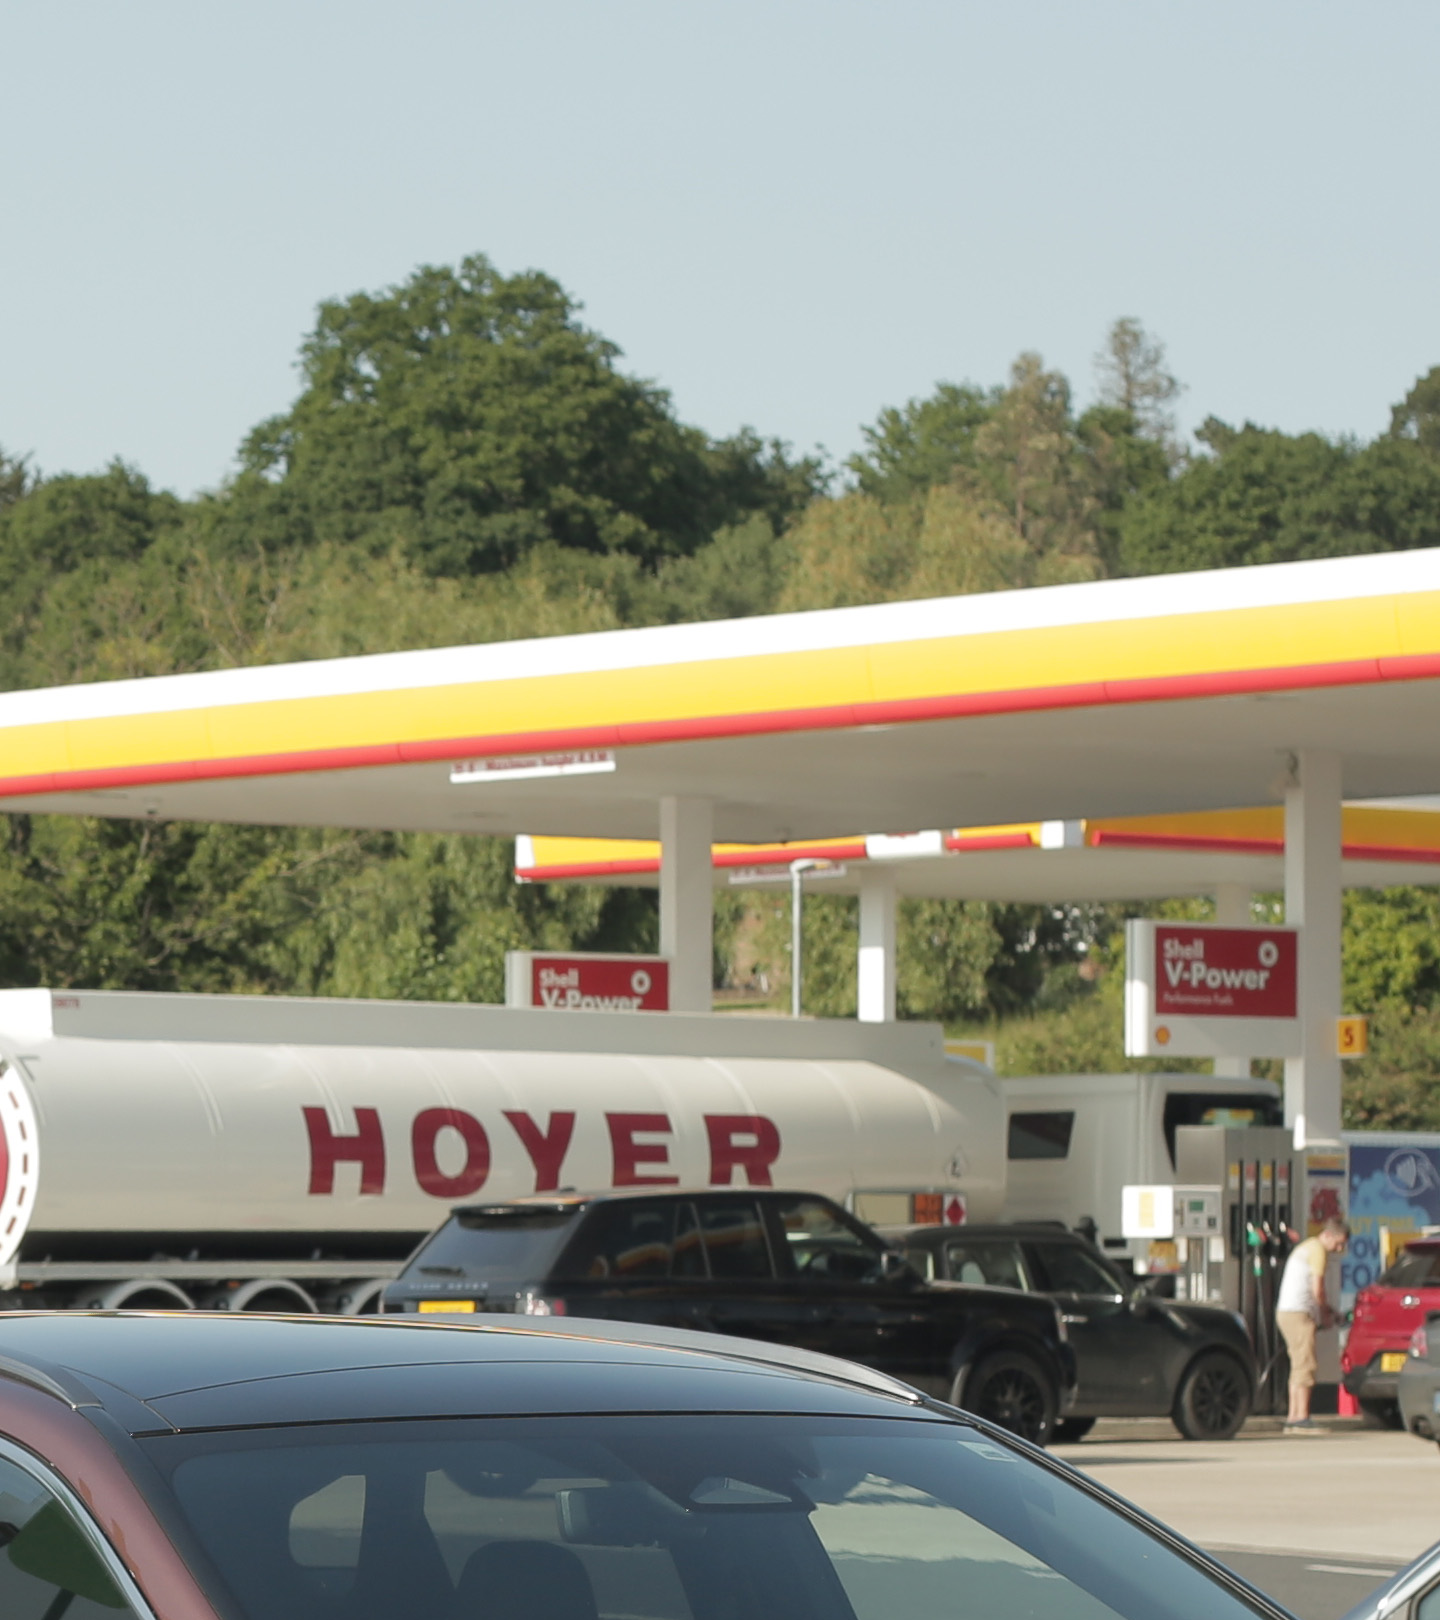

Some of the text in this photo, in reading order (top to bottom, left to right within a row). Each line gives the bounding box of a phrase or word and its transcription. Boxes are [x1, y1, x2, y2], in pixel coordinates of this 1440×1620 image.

[1163, 938, 1204, 959] Shell
[539, 968, 580, 988] Shell
[1164, 960, 1270, 991] V-Power
[540, 988, 644, 1011] V-Power
[1344, 1026, 1355, 1048] 5
[301, 1105, 782, 1199] HOYER
